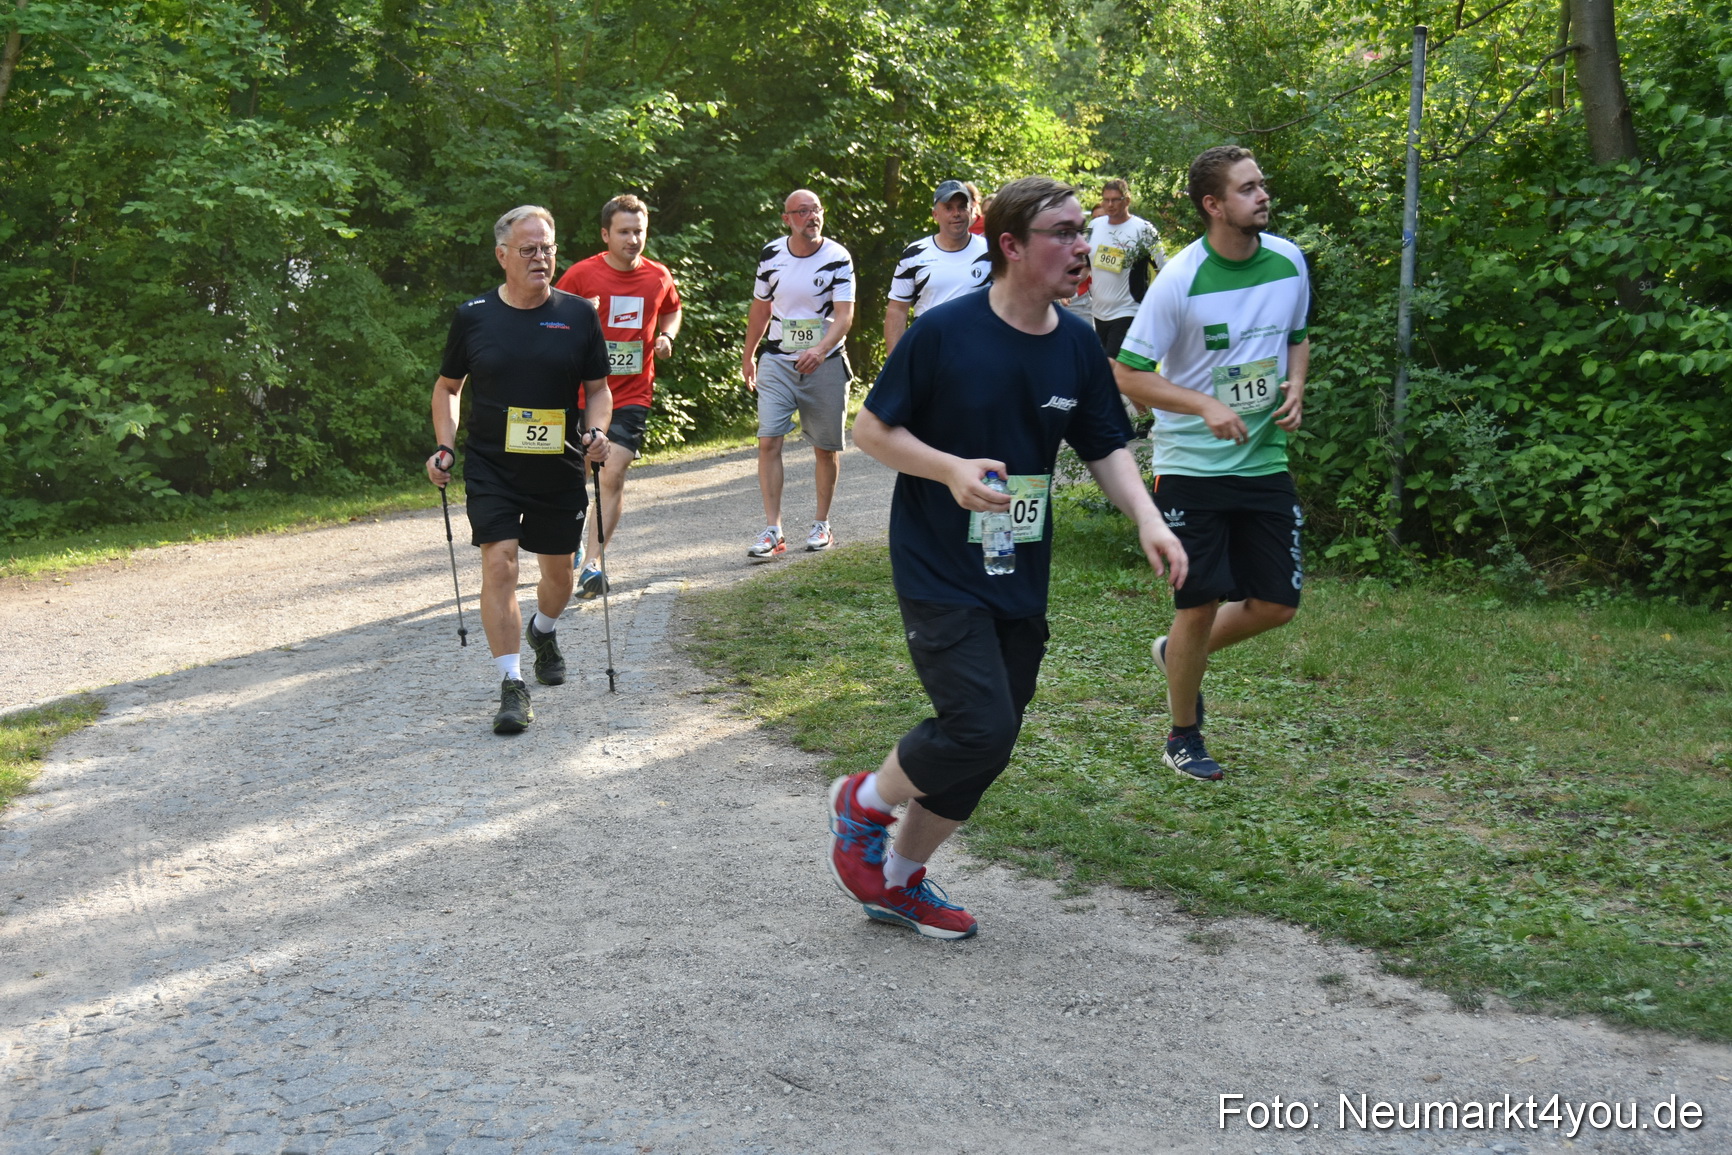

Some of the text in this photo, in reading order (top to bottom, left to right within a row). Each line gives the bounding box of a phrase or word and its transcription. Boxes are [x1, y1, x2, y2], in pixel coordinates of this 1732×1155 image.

[1100, 253, 1117, 265] 960
[790, 329, 814, 341] 798
[1205, 332, 1229, 342] BayWa
[609, 353, 634, 366] 522
[1230, 378, 1267, 402] 118
[526, 425, 548, 442] 52
